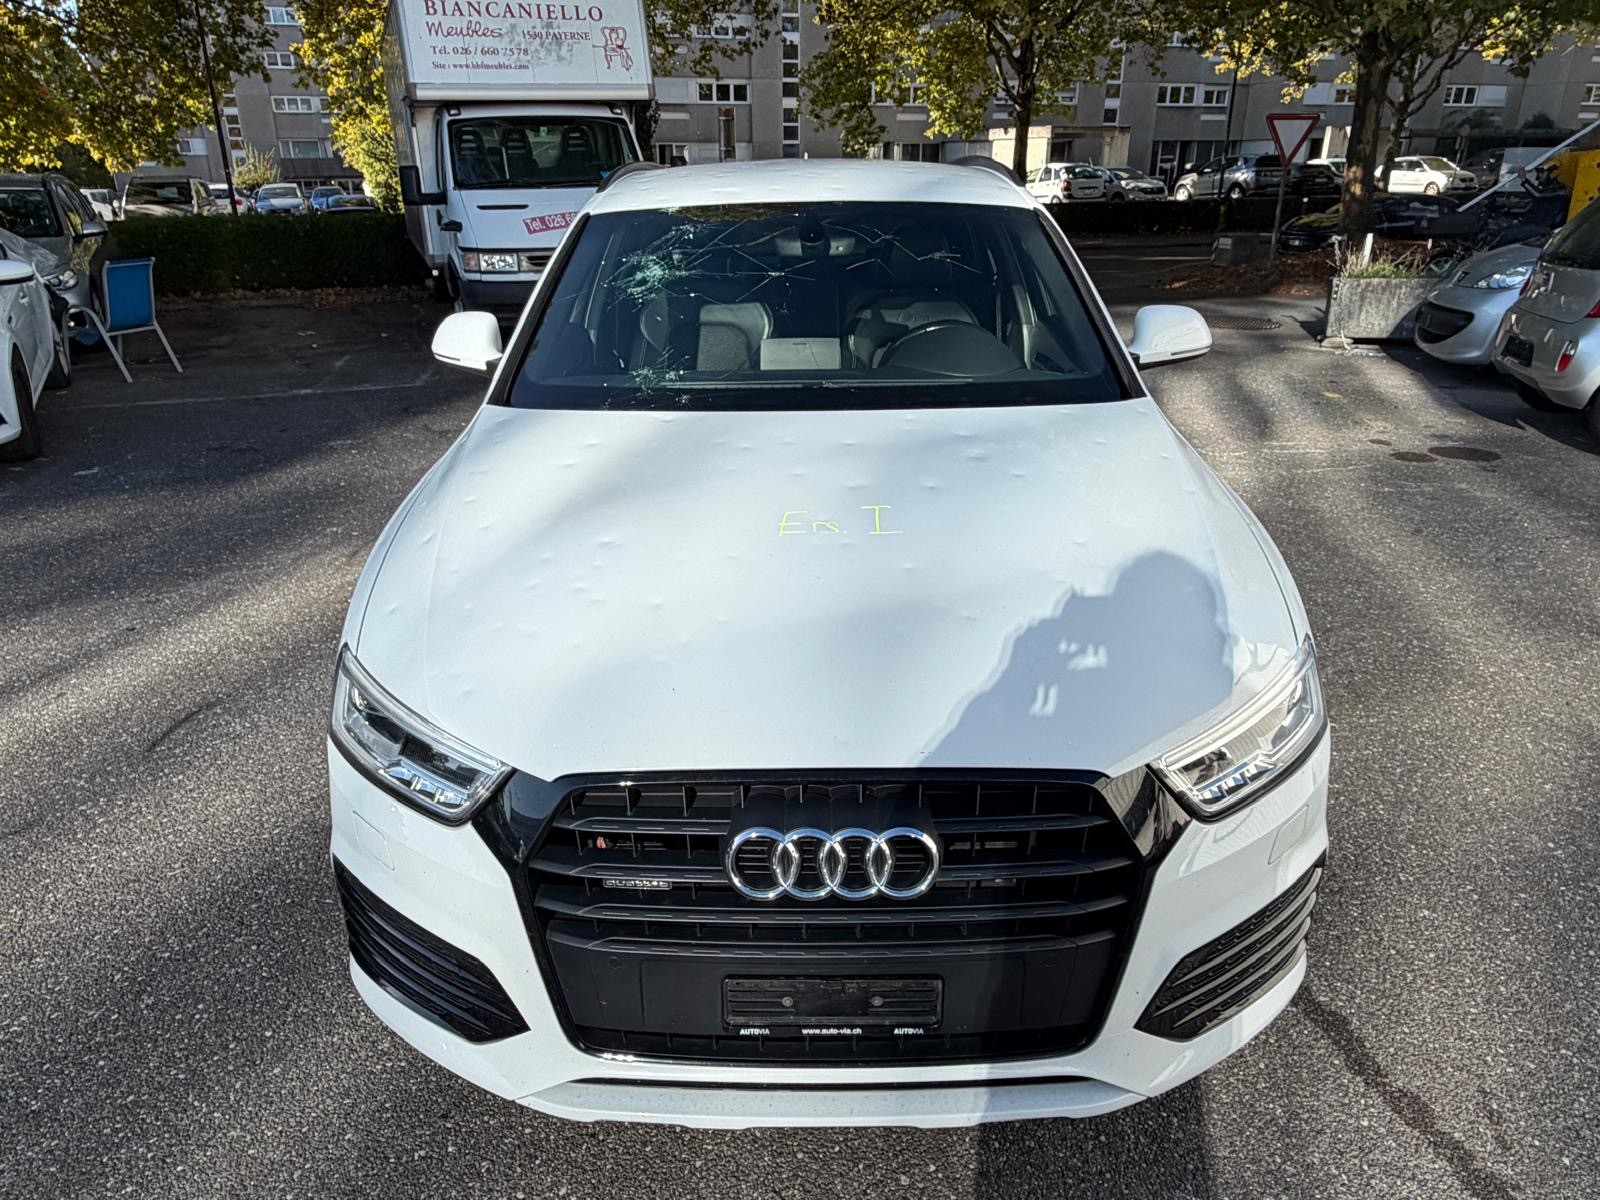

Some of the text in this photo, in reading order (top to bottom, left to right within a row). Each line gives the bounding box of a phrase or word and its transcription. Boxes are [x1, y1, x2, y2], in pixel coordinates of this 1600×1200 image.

[424, 0, 603, 21] BIANCANIELLO
[426, 20, 503, 38] Meubles
[545, 31, 591, 40] PAYERNE
[430, 45, 450, 55] Tél.
[452, 46, 472, 56] 026
[480, 47, 500, 56] 660
[525, 218, 546, 231] Tel.
[545, 214, 566, 228] 026
[860, 505, 904, 535] I
[739, 1027, 924, 1036] AUTOVIA www.auto-via.ch AUTOVIA
